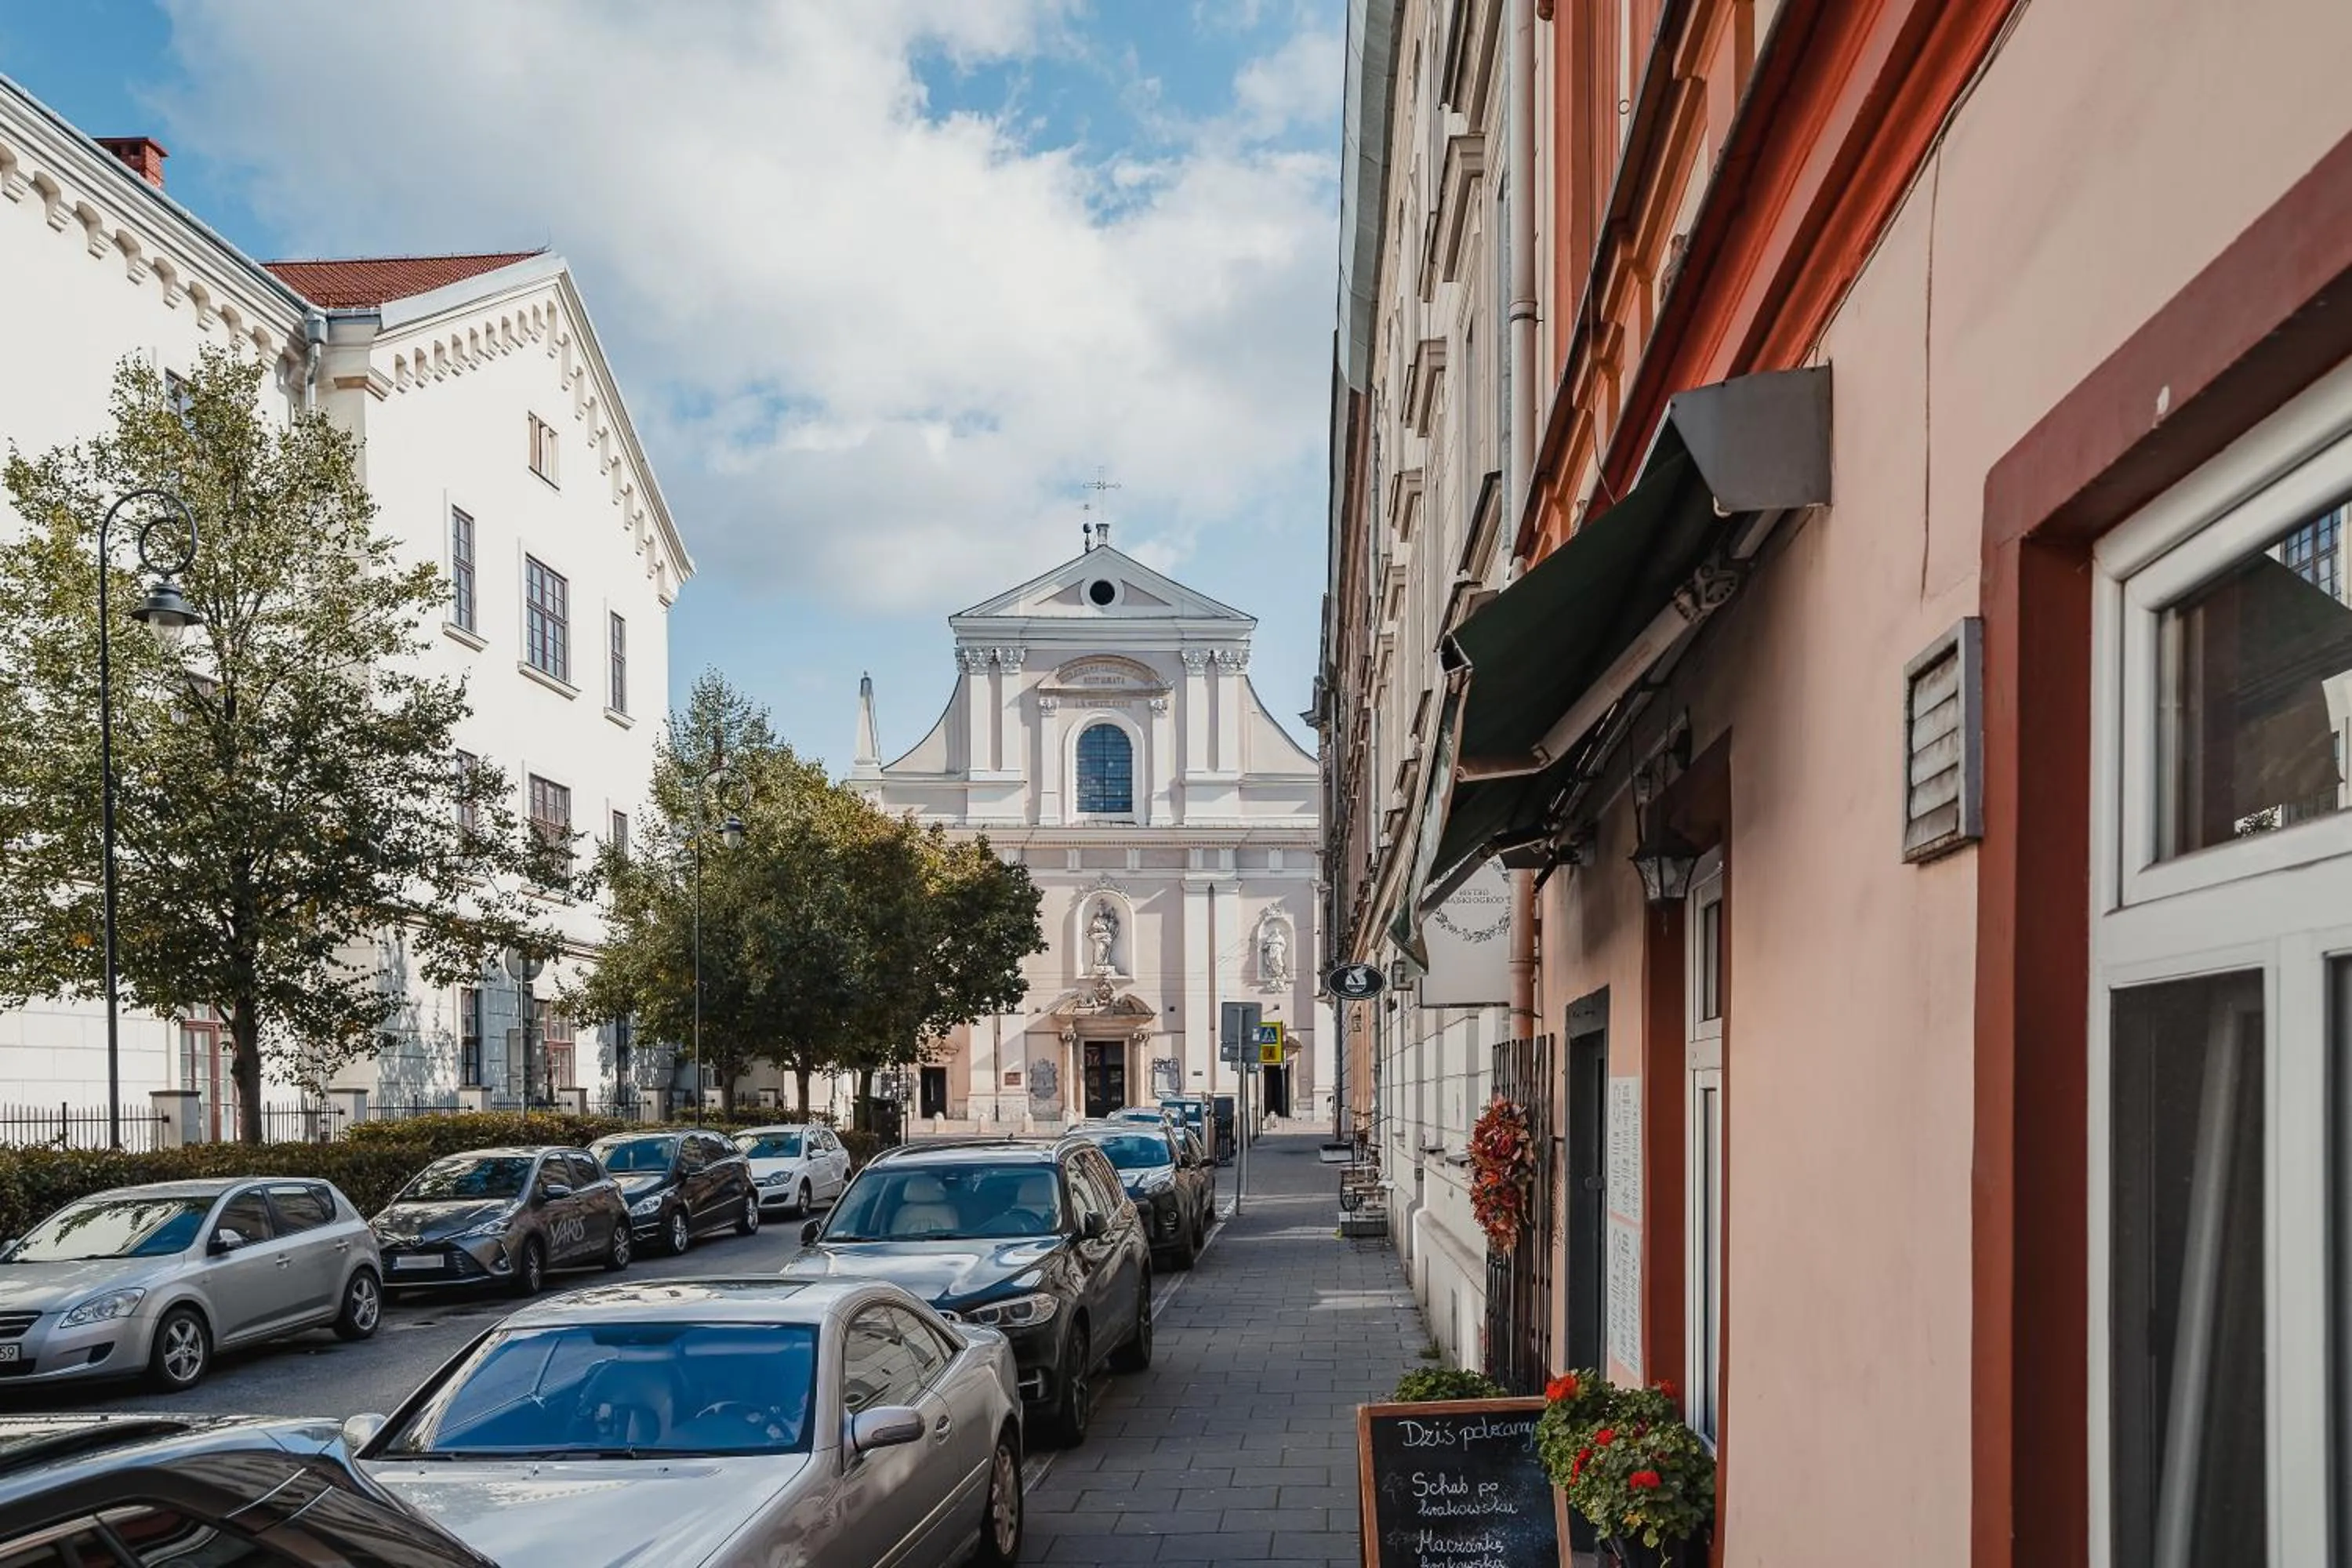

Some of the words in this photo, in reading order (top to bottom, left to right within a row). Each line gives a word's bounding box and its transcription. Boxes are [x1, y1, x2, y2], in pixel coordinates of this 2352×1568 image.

[1398, 1421, 1456, 1447] Dziś
[1412, 1472, 1468, 1497] Schab
[1478, 1480, 1499, 1497] po
